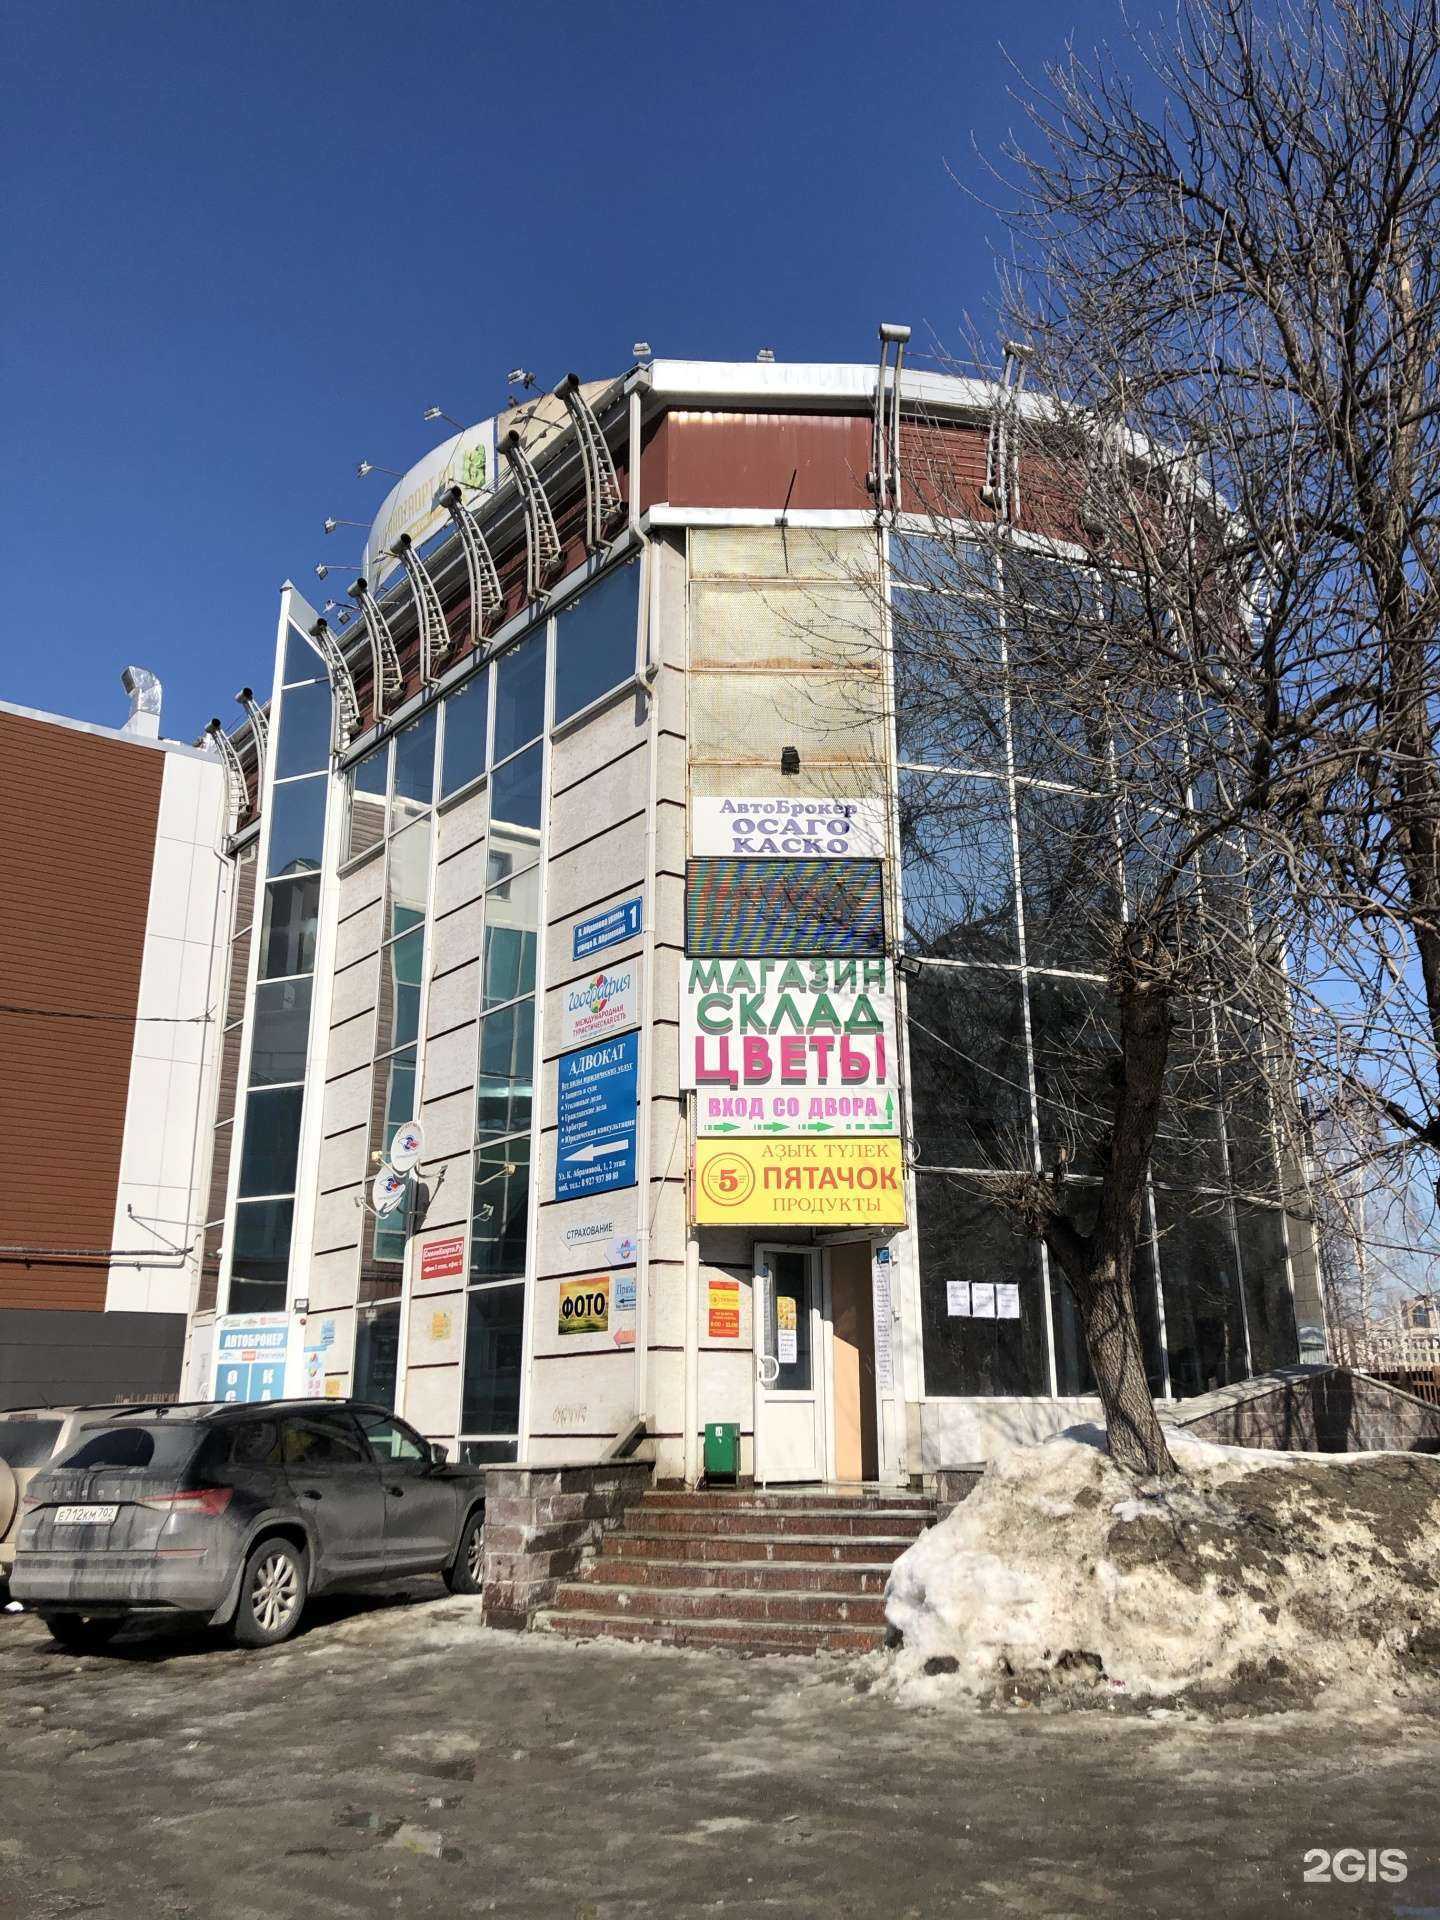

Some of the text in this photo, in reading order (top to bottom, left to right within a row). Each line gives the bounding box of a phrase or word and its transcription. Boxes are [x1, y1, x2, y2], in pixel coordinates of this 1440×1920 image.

[720, 799, 857, 818] АвтоБрокер
[732, 818, 850, 836] ОСАГО
[732, 838, 849, 854] КАСКО
[630, 905, 637, 928] 1
[688, 959, 886, 994] МАГАЗИН
[575, 1003, 624, 1028] МЕЖДУНАРОДНАЯ
[697, 992, 884, 1035] СКЛАД
[568, 1043, 626, 1076] АДВОКАТ
[695, 1036, 887, 1091] ЦВЕТЫ
[708, 1097, 878, 1120] ВХОД СО ДВОРА
[719, 1169, 738, 1192] 5
[763, 1166, 897, 1190] ПЯТАЧОК
[773, 1198, 881, 1214] ПРОДУКТЫ
[567, 1222, 613, 1240] СТРАХОВАНИЕ
[562, 1292, 606, 1319] ФОТО
[224, 1332, 284, 1349] АВТОБРОКЕР
